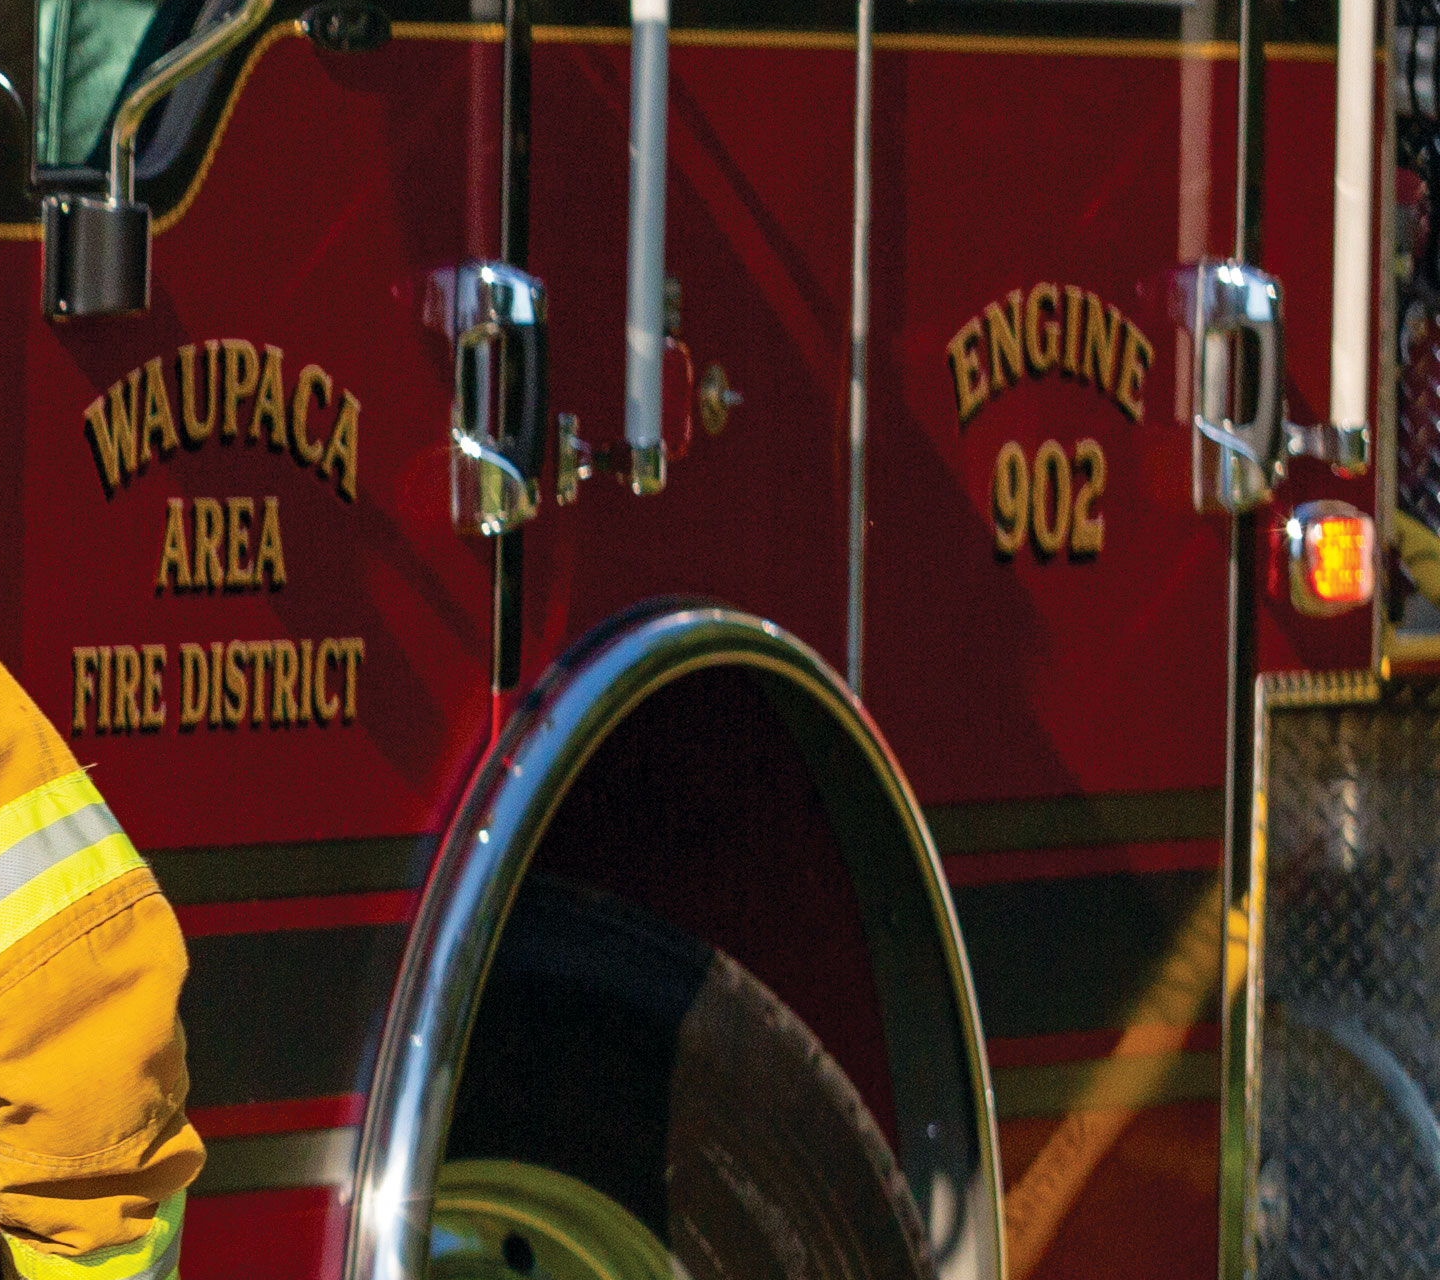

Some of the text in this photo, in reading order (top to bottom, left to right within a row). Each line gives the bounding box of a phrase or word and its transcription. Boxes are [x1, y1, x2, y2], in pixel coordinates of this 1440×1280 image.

[946, 281, 1154, 423] ENGINE
[84, 338, 364, 502] WAUPACA
[157, 496, 286, 592] AREA
[992, 439, 1107, 558] 902
[72, 636, 365, 732] FIRE DISTRICT
